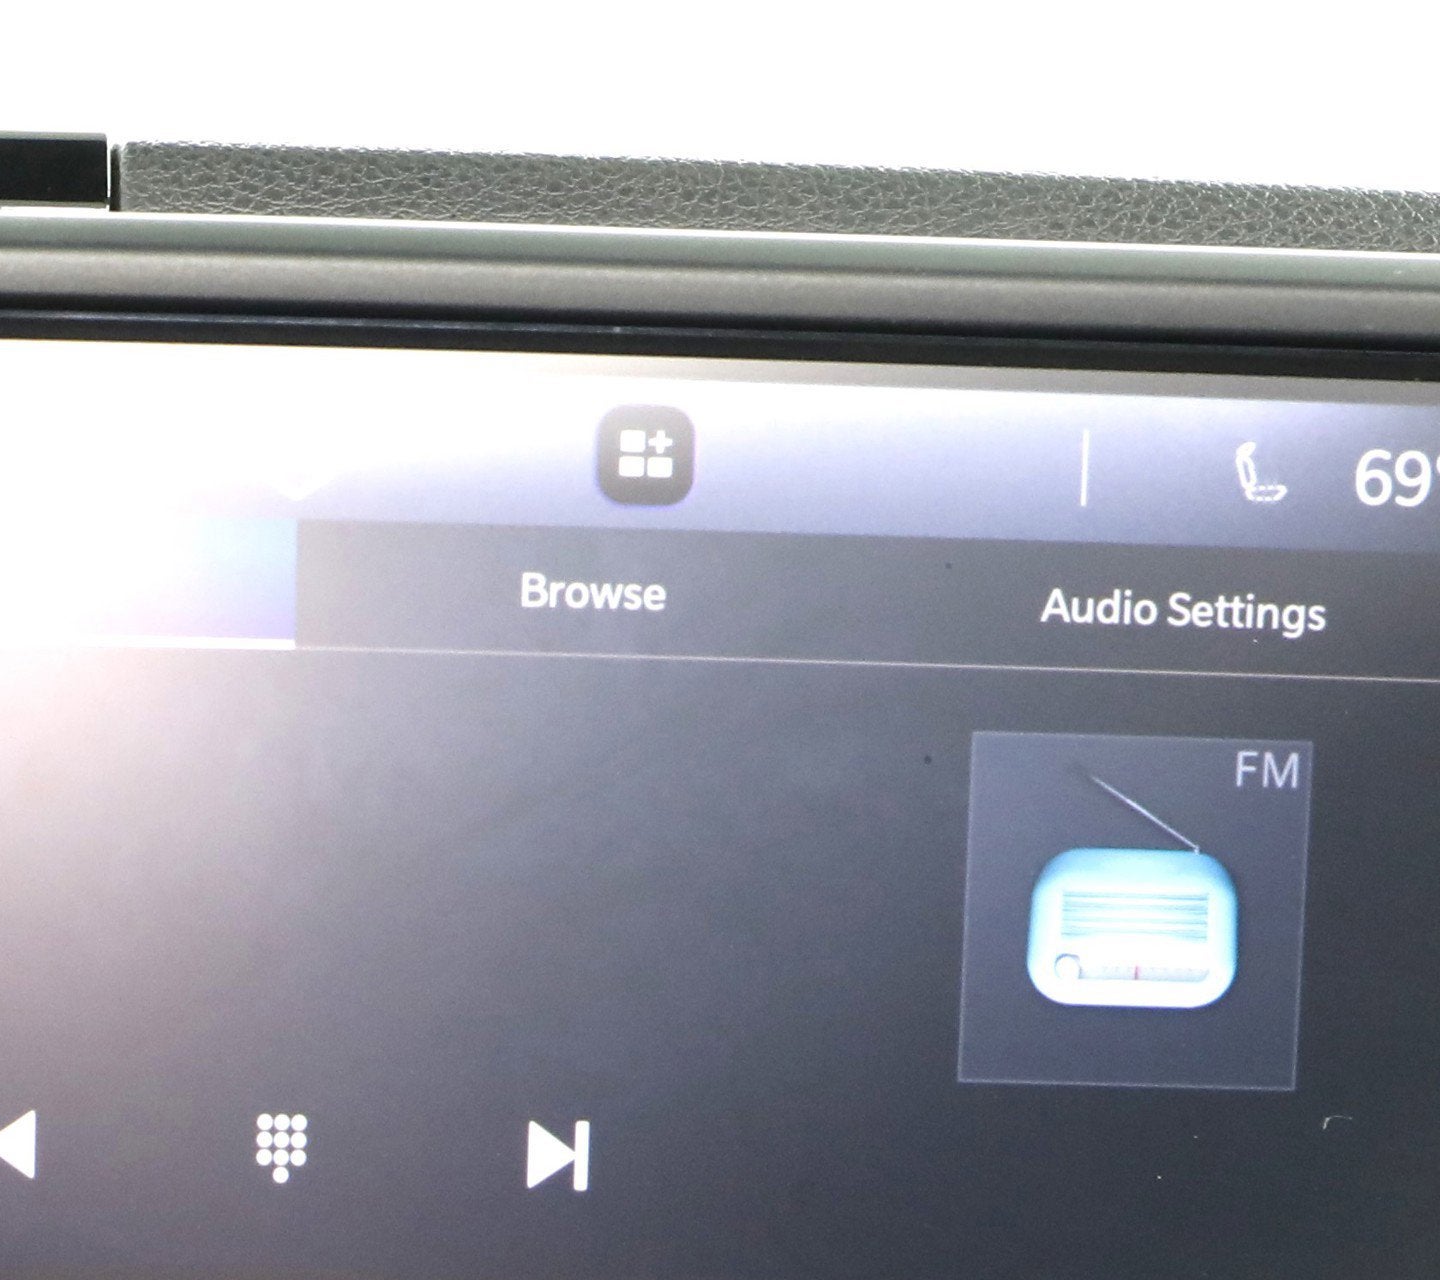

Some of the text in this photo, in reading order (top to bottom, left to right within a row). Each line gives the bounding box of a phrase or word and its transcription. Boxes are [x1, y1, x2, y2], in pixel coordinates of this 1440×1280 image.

[521, 572, 667, 612] Browse
[1040, 587, 1327, 633] Audio Settings
[1234, 751, 1299, 788] FM
